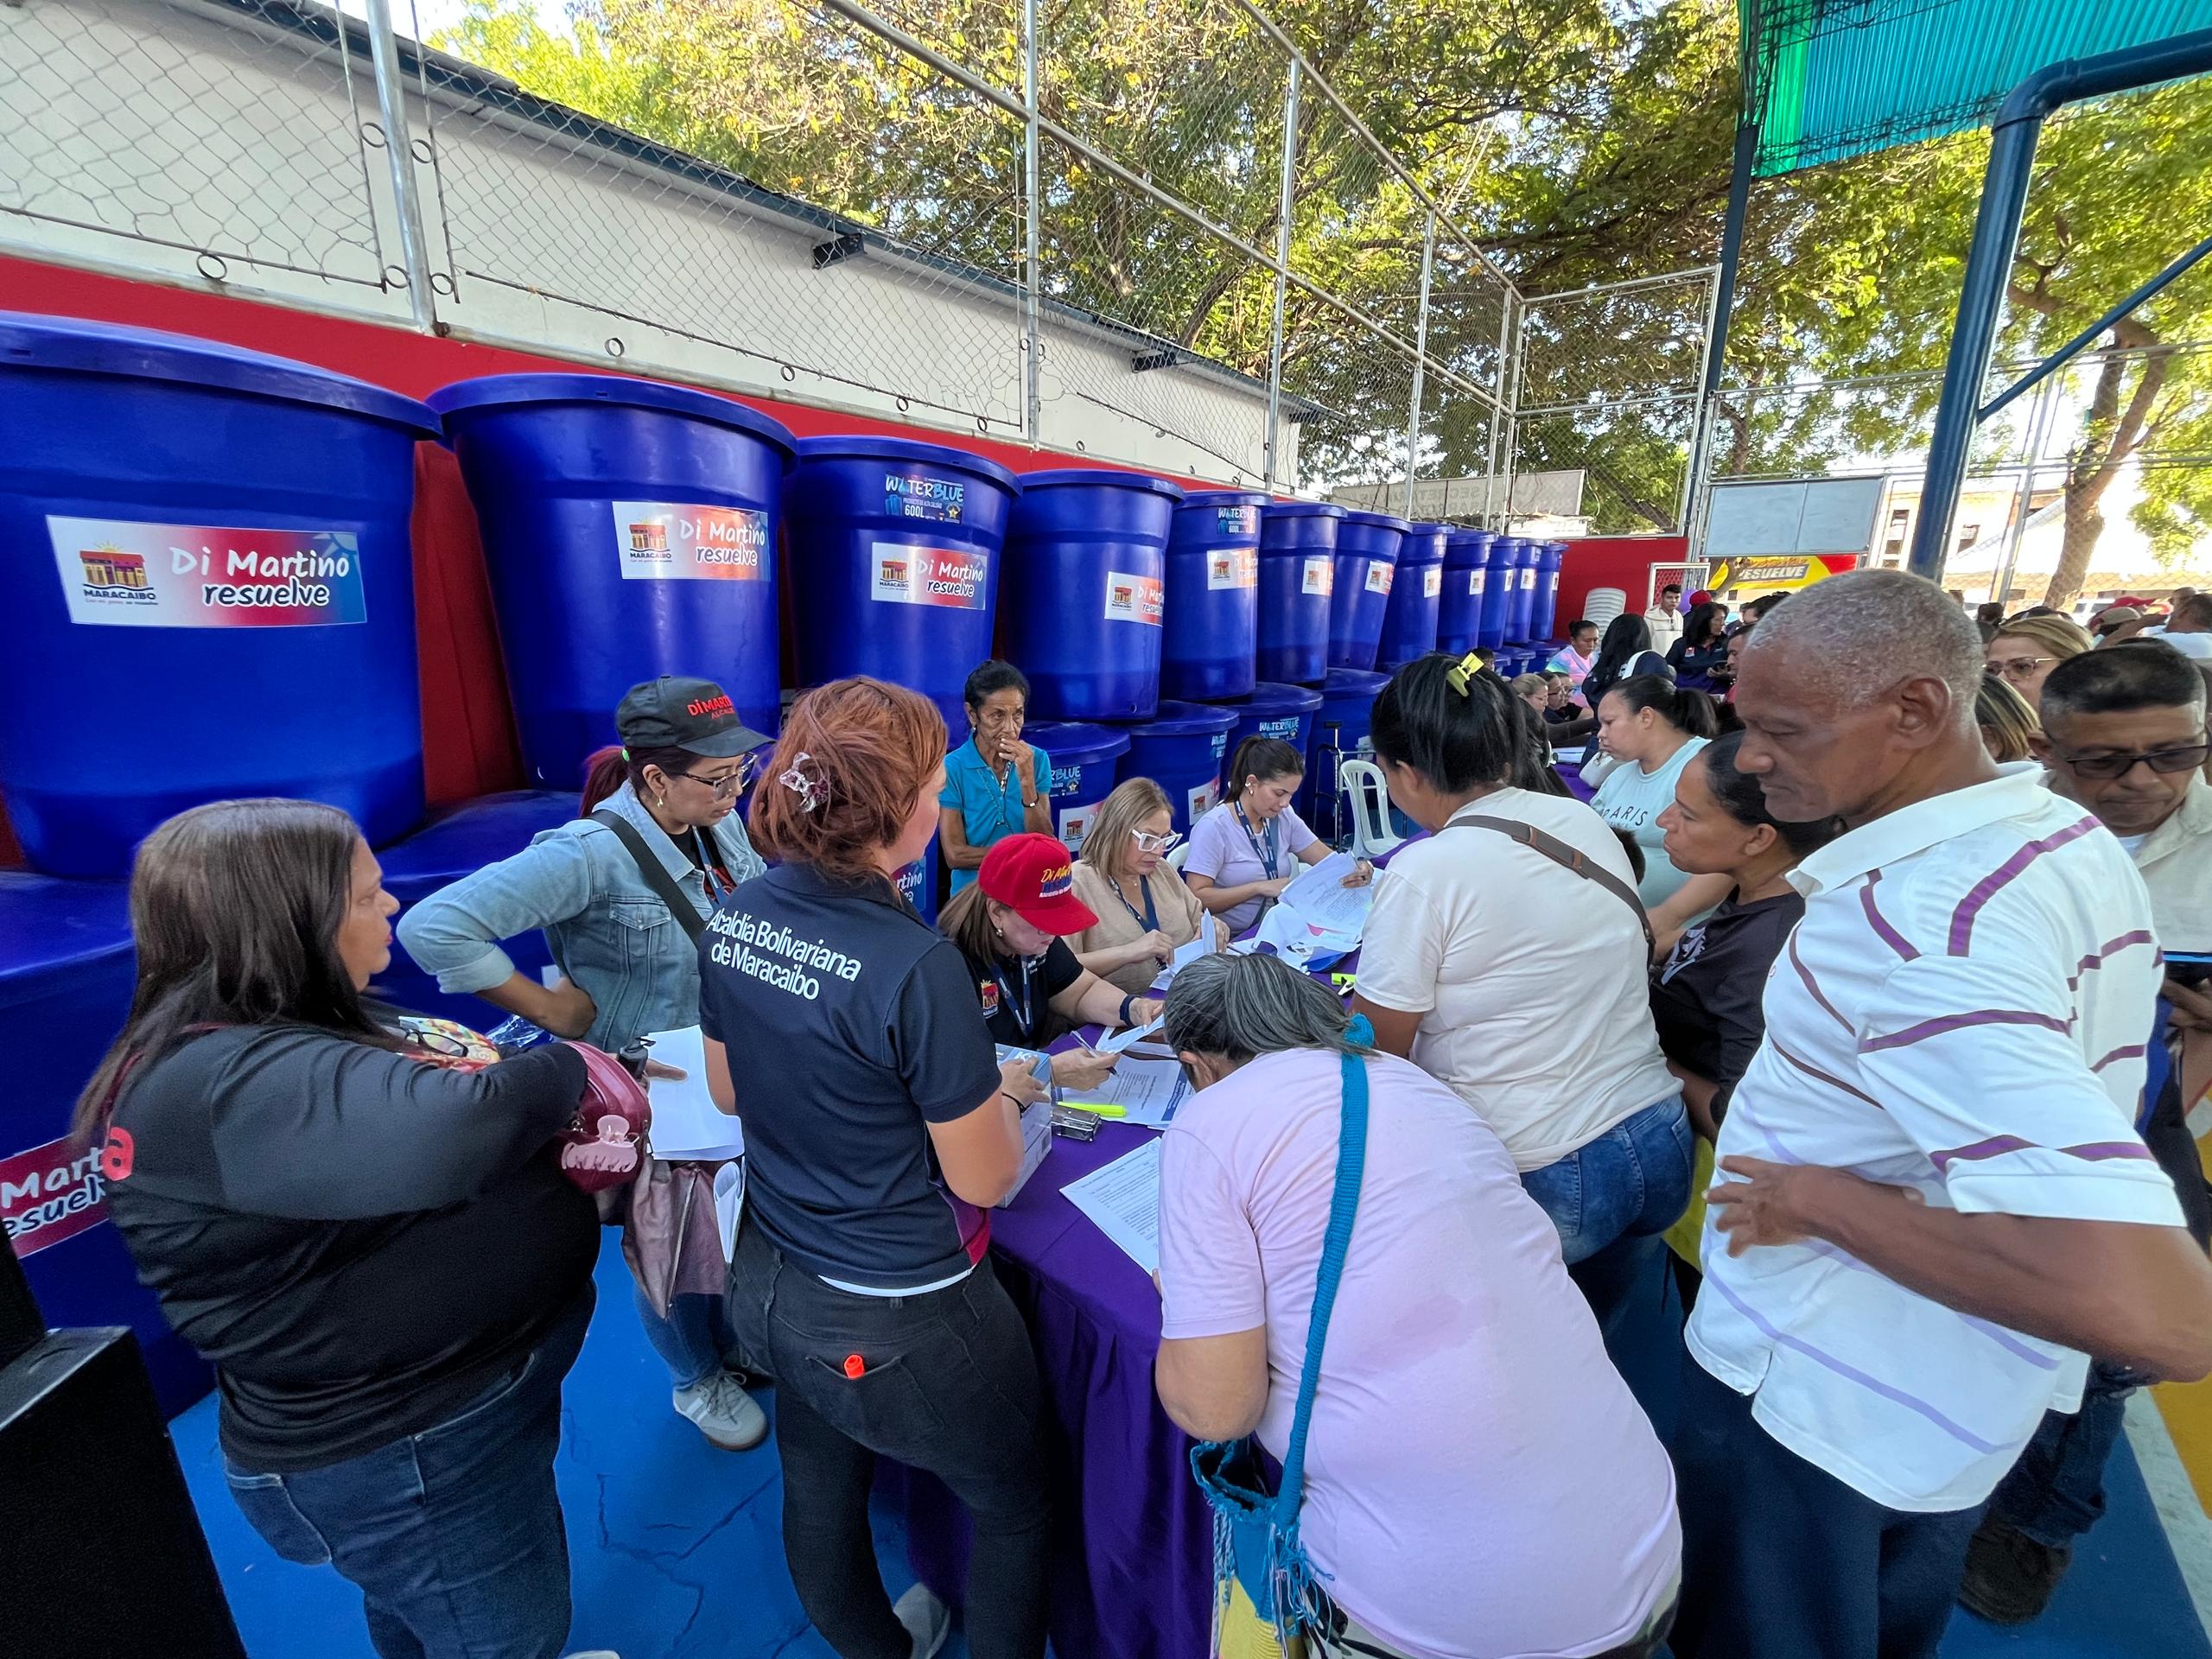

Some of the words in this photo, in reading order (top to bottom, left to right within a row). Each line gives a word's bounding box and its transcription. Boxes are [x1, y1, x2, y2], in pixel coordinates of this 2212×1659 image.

[905, 504, 925, 518] 600L
[679, 518, 701, 540] Di
[709, 520, 766, 546] Martino
[168, 546, 211, 575] Di
[227, 546, 350, 578] Martino
[696, 543, 757, 566] resuelve
[916, 559, 934, 575] Di
[938, 561, 982, 582] Martino
[84, 589, 156, 600] MARACAIBO
[203, 576, 329, 606] resuelve
[927, 580, 974, 597] resuelve
[702, 695, 733, 712] MARTI
[1051, 766, 1081, 780] RBLUE
[897, 872, 922, 889] rtino
[706, 907, 756, 943] Alcaldía
[754, 920, 861, 982] Bolivariana
[711, 937, 732, 966] de
[731, 943, 820, 1000] Maracaibo
[1, 1147, 104, 1209] Mart
[3, 1173, 105, 1239] esuel
